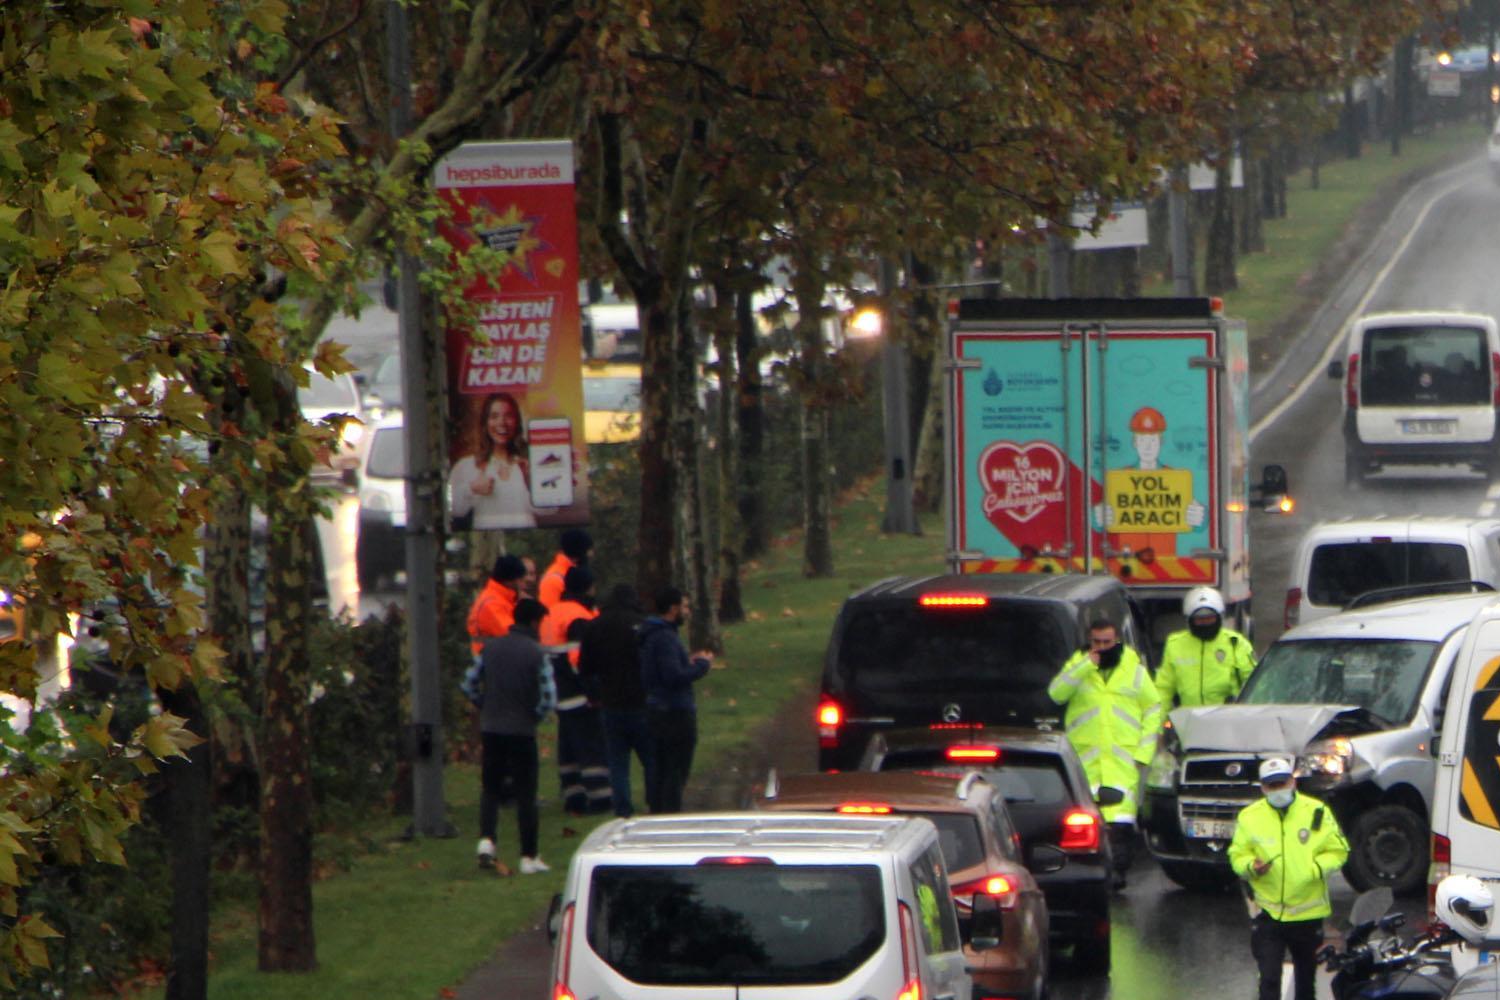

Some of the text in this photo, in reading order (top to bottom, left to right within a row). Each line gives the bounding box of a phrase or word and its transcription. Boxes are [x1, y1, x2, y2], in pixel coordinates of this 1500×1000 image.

[447, 162, 561, 184] hepsiburada
[516, 344, 546, 363] DE
[467, 366, 542, 386] KAZAN
[1130, 477, 1168, 491] YOL
[1117, 494, 1181, 508] BAKIM
[1119, 511, 1180, 525] ARACI
